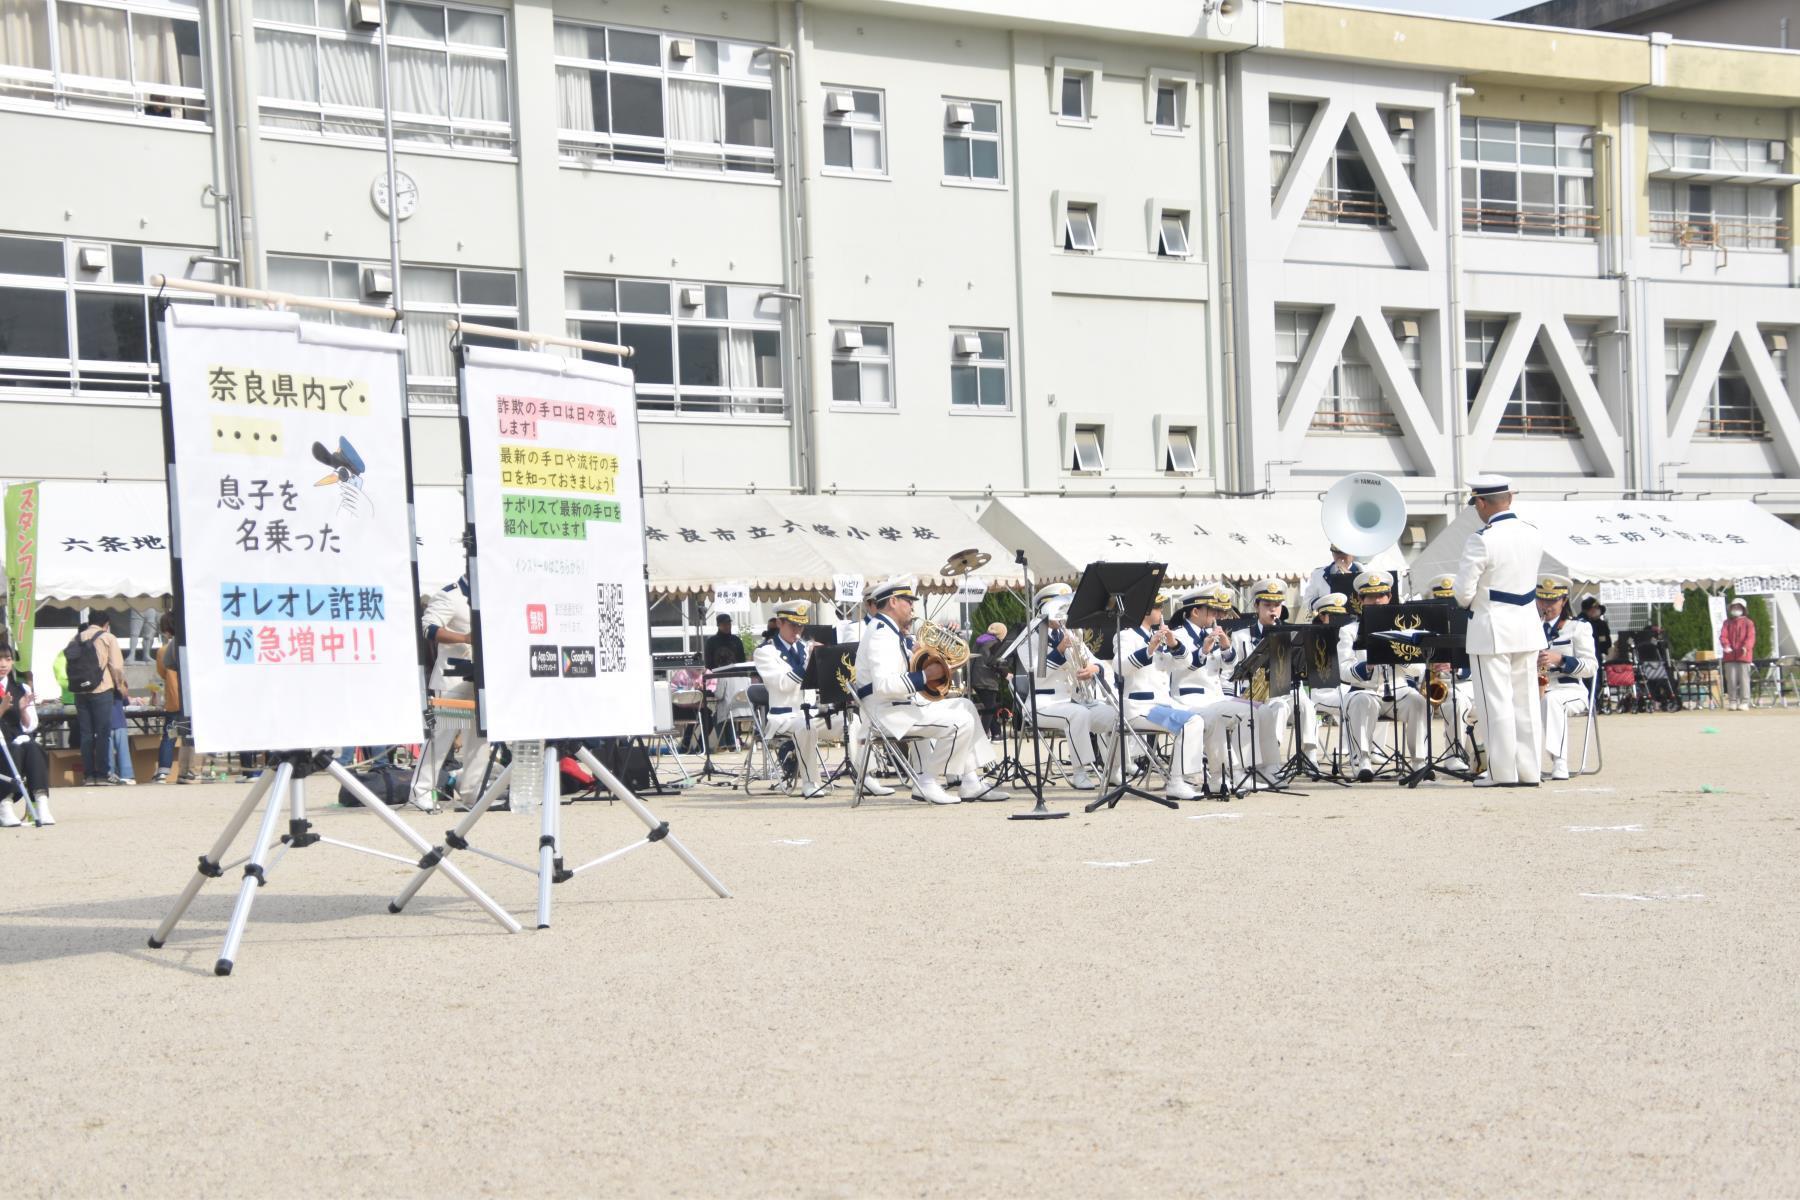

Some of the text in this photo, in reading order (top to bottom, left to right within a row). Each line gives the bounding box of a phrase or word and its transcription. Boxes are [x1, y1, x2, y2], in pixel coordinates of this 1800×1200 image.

[498, 398, 617, 426] 詐欺の手口は日々変化
[501, 447, 619, 472] 最新の手口や流行の手
[217, 475, 298, 511] 息子を
[1360, 478, 1382, 486] YAMAHA
[61, 534, 167, 553] 六条地
[235, 519, 341, 553] 名乗った
[222, 586, 384, 621] オレオレ詐欺
[538, 651, 557, 663] App Store
[571, 650, 594, 665] Google Play
